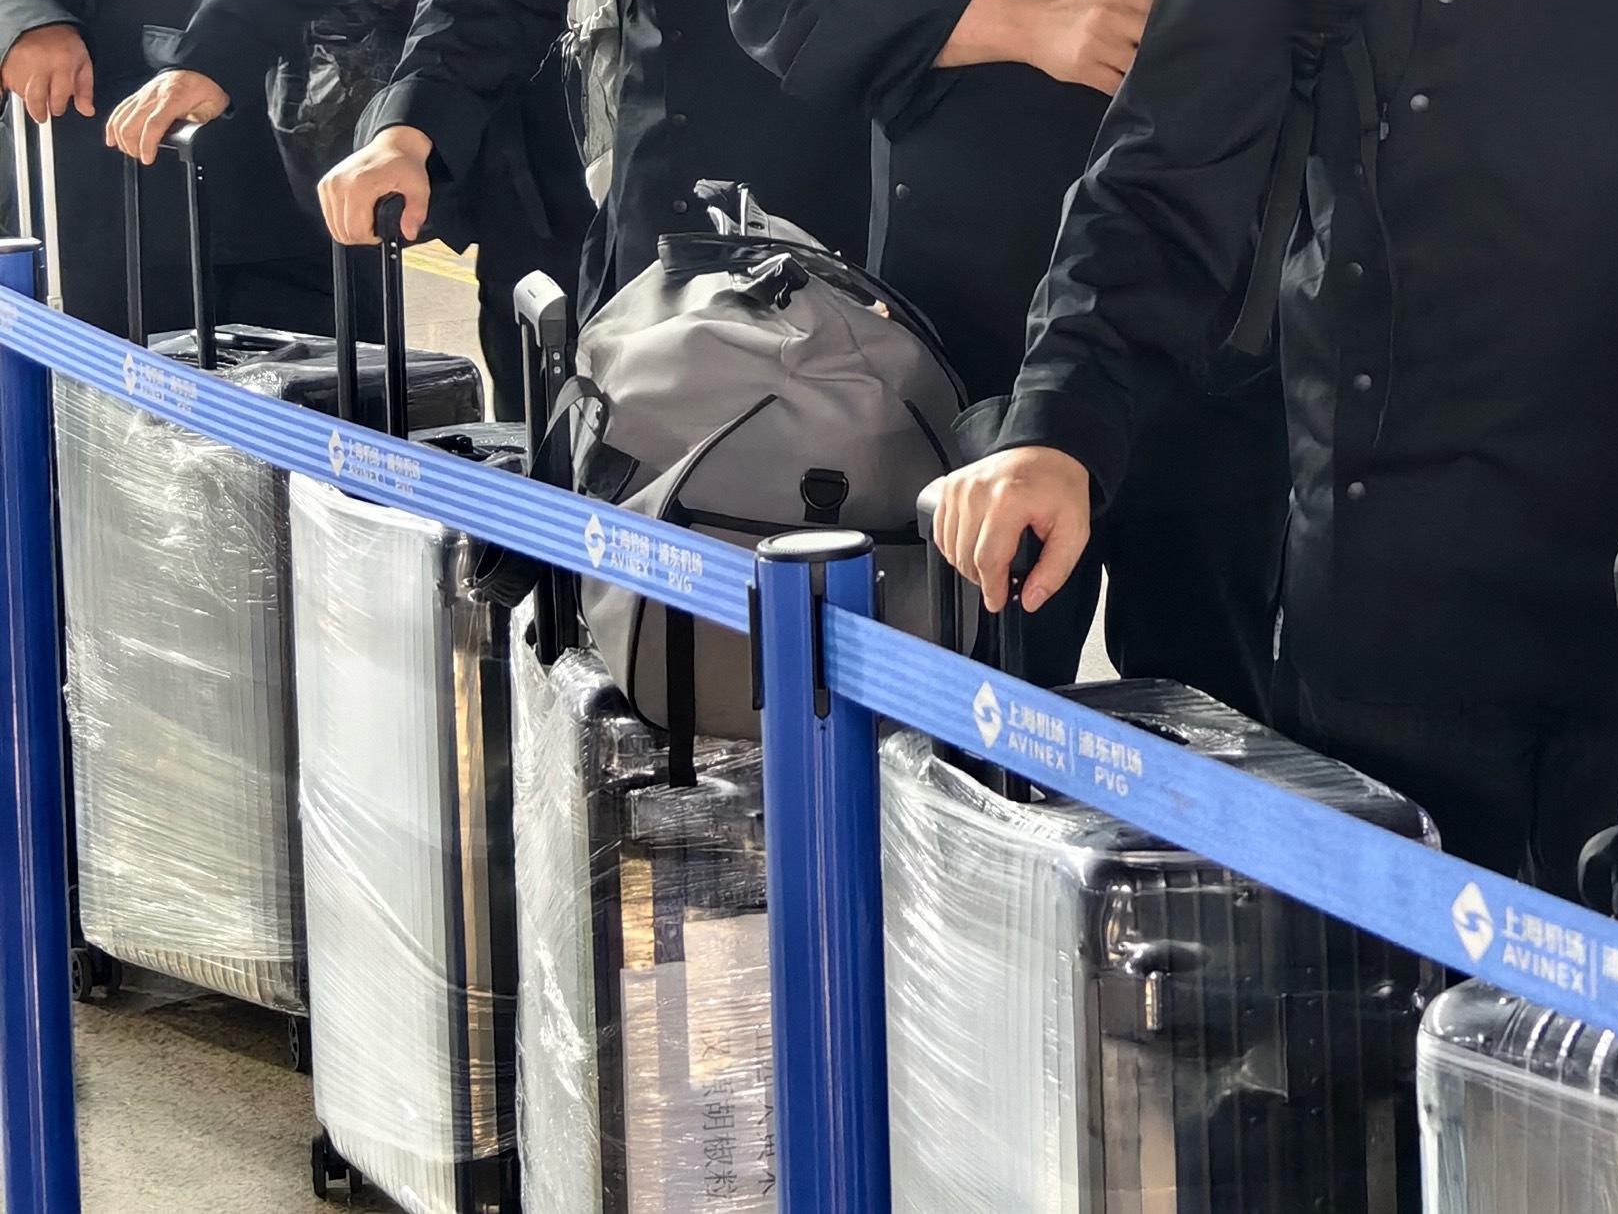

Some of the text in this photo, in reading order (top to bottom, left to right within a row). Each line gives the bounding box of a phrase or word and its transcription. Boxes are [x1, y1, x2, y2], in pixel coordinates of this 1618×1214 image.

[1007, 700, 1067, 747] 上海机场
[1008, 731, 1129, 797] AVINEX PVG
[1502, 906, 1586, 966] 上海机场
[1502, 942, 1585, 996] AVINEX
